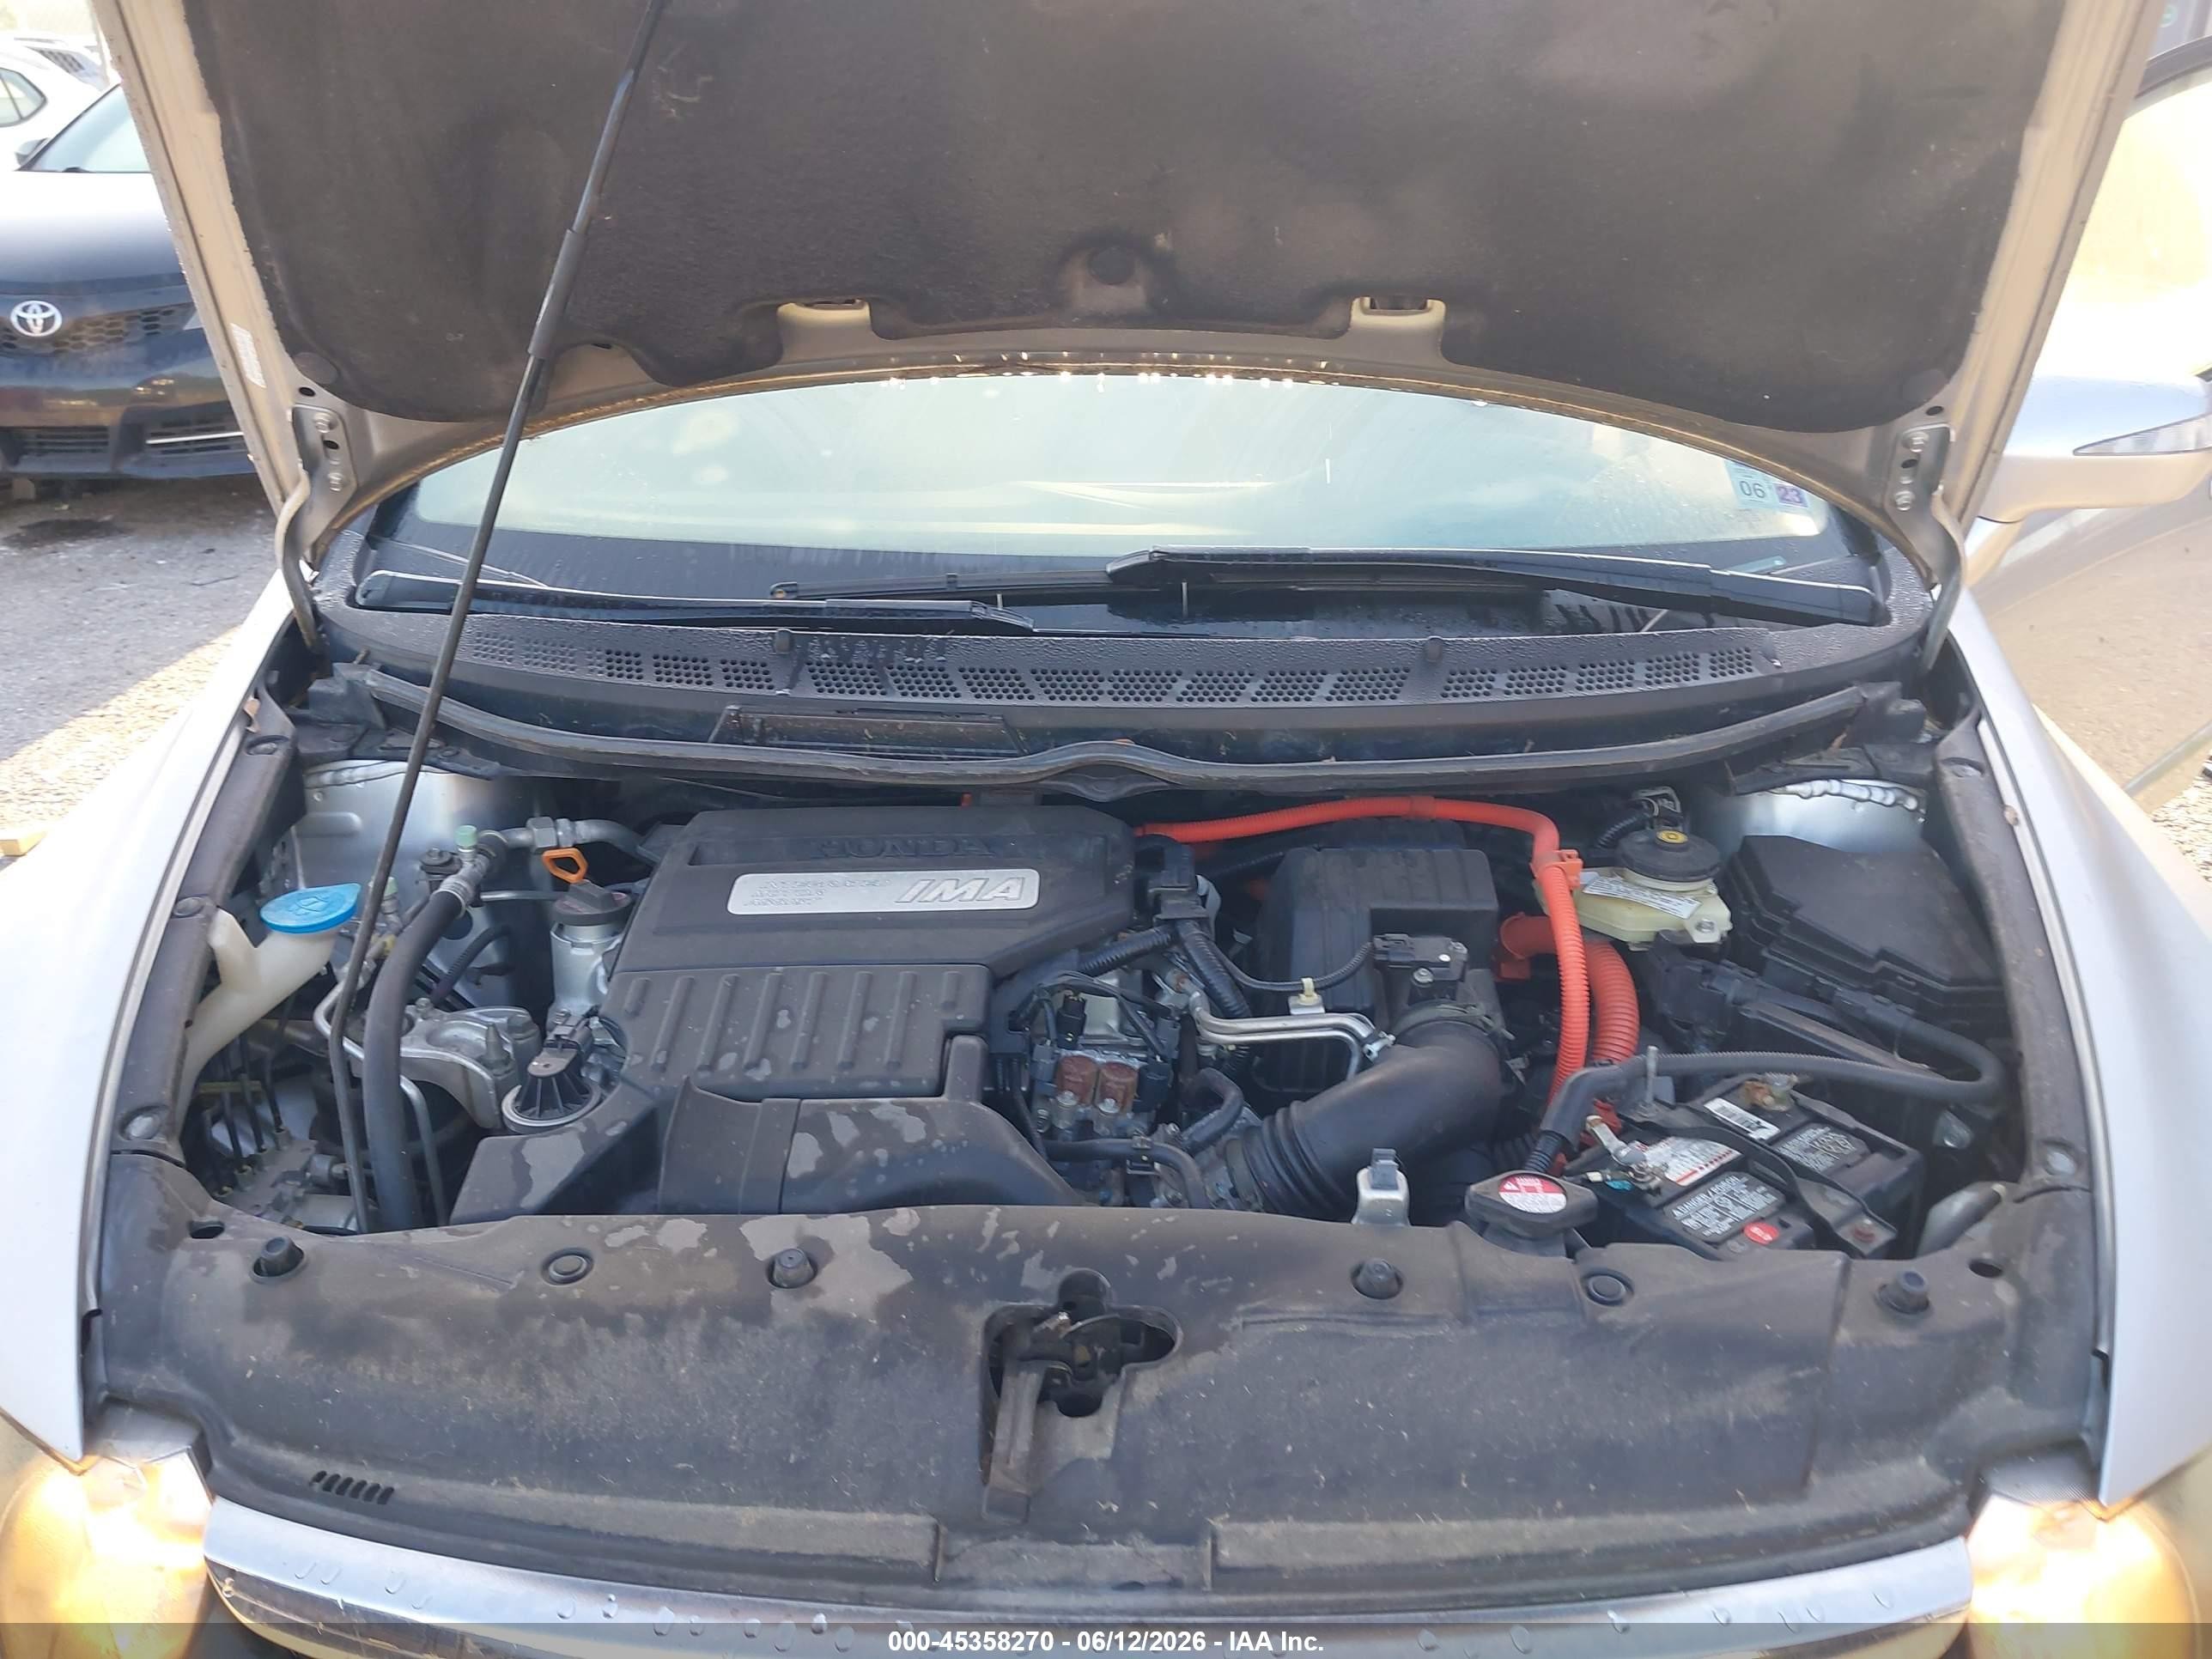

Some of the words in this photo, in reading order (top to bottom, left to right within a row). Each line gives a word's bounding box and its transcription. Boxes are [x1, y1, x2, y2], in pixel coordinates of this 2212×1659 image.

[1740, 481, 1765, 498] 06
[1777, 486, 1803, 504] 23
[811, 837, 995, 859] HONDA
[895, 876, 1025, 903] IMA
